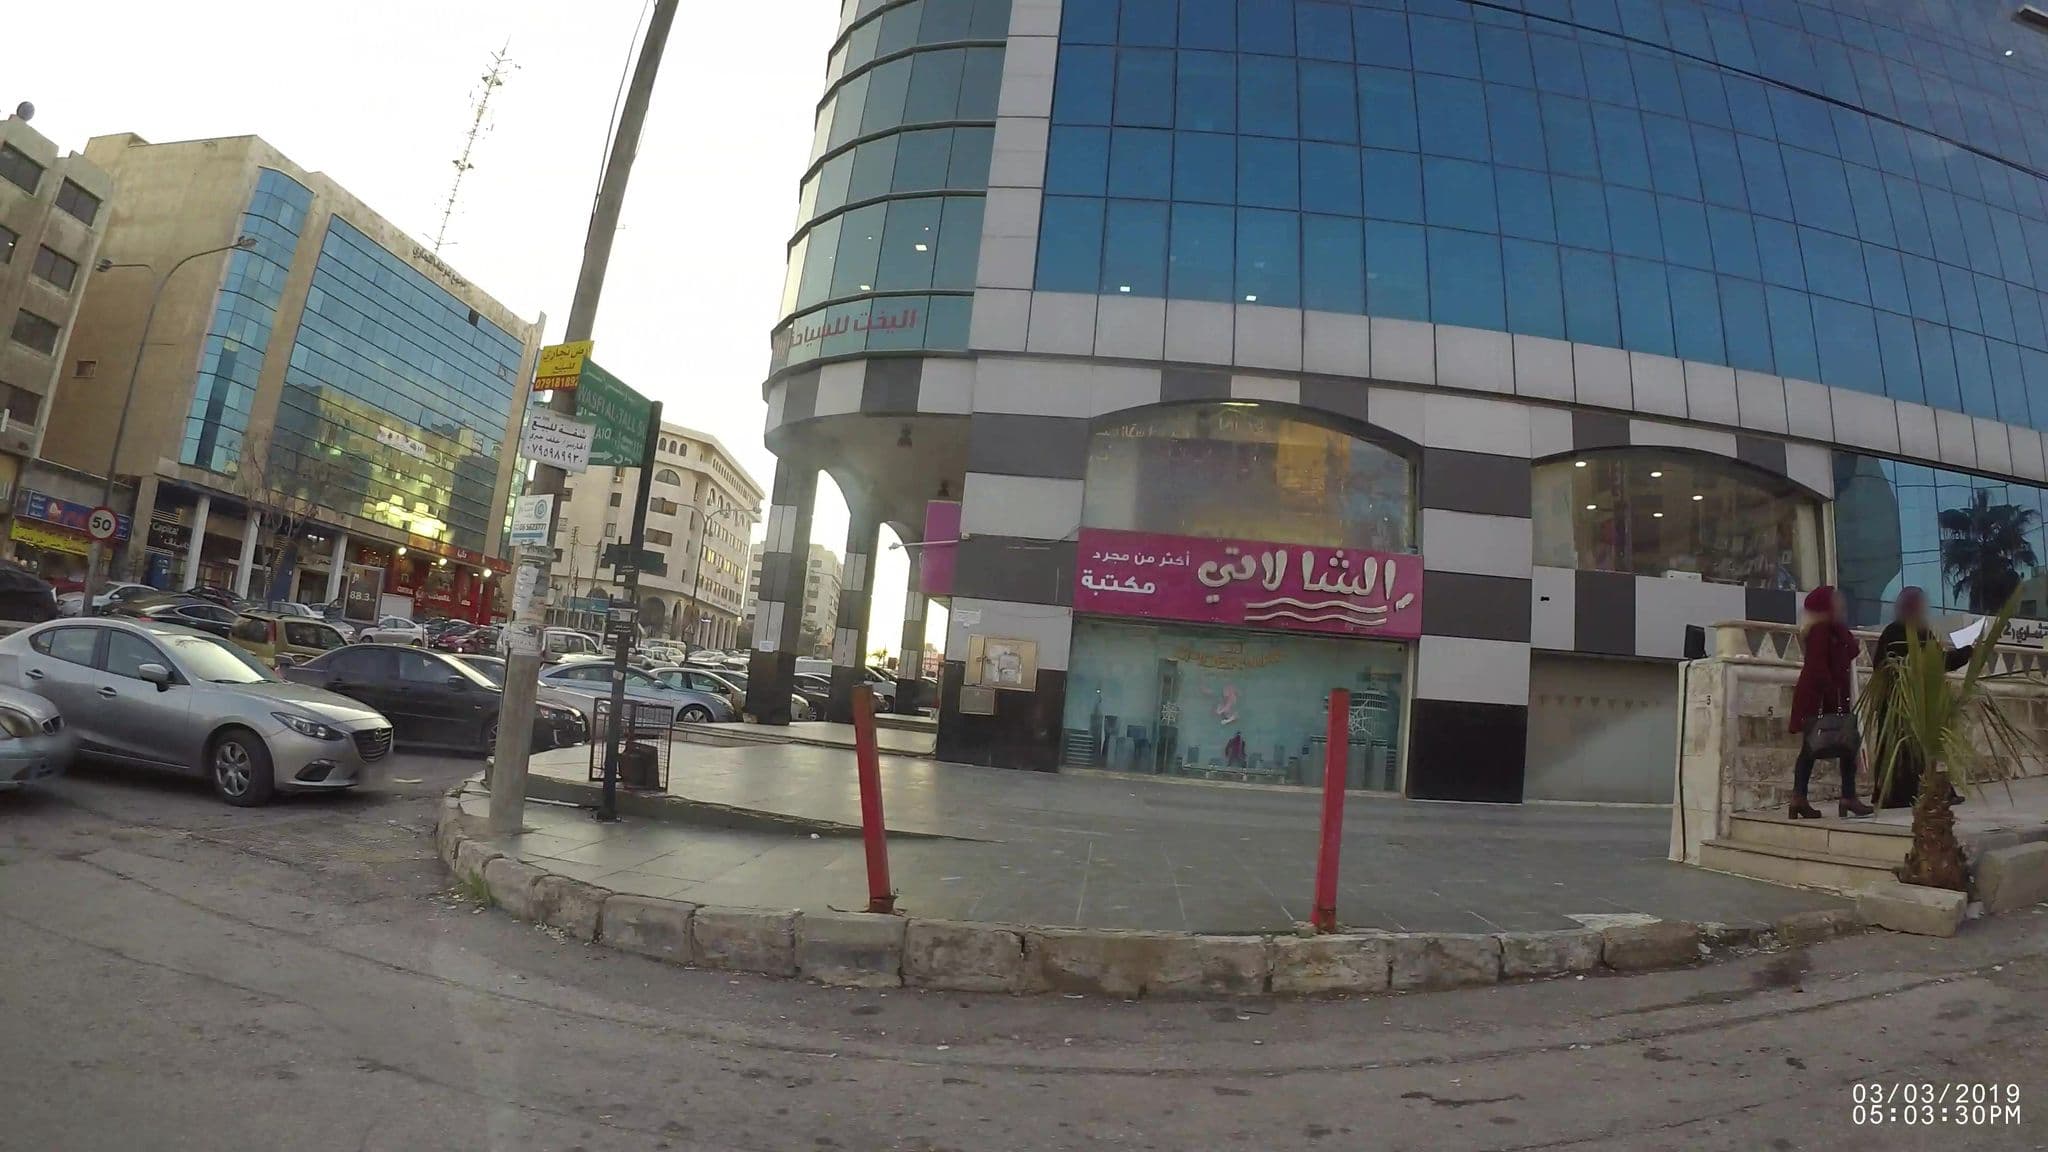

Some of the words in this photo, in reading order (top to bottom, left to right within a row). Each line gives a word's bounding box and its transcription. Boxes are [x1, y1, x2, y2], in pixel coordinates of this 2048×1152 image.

[531, 420, 558, 433] للبيع
[594, 427, 612, 440] AIQ
[92, 517, 112, 531] 50
[1092, 551, 1130, 562] مجرد
[1134, 551, 1155, 564] من
[1159, 550, 1190, 567] أكثر
[1081, 569, 1156, 597] مكتبة
